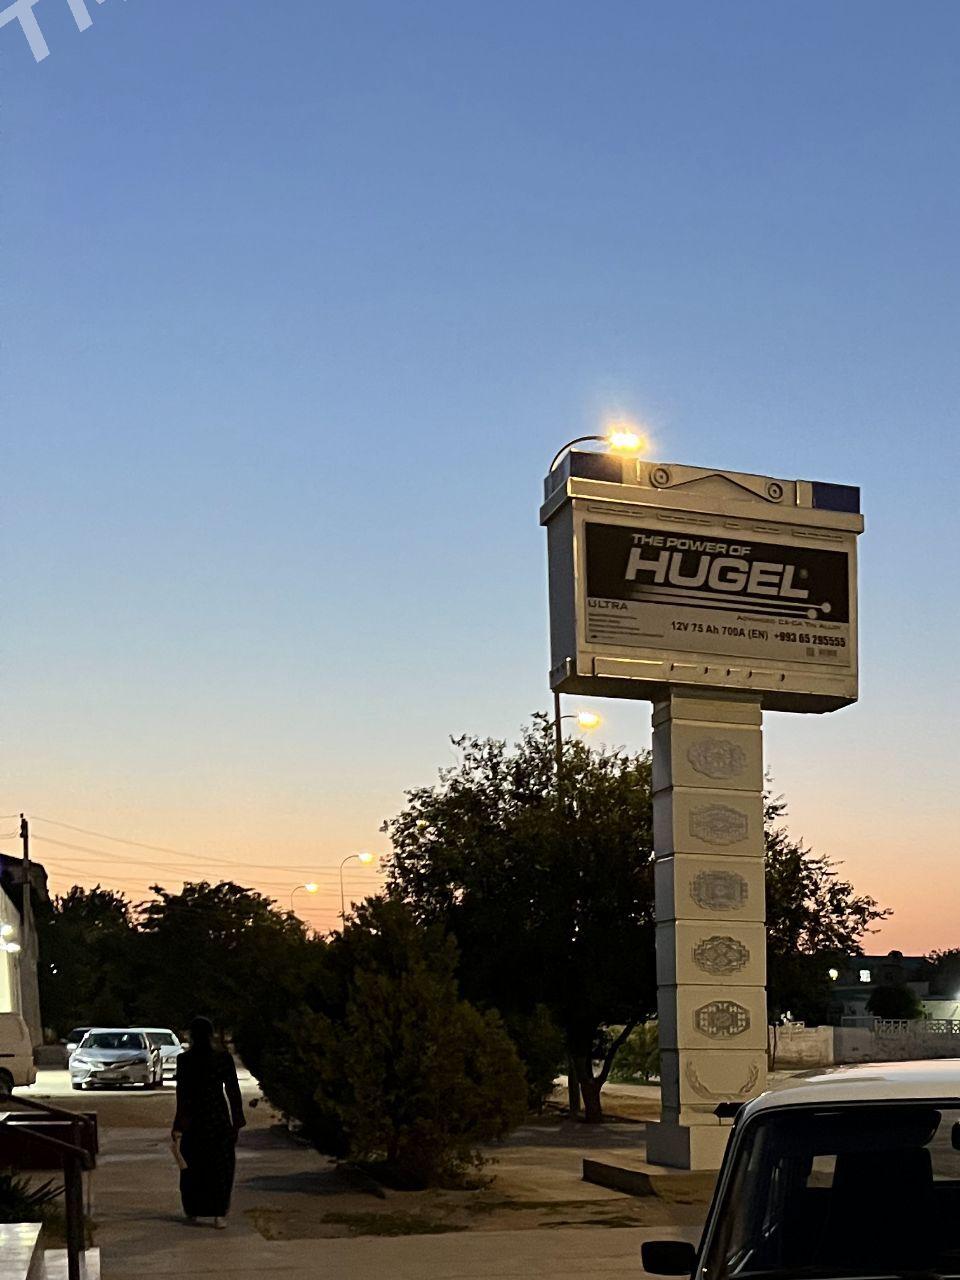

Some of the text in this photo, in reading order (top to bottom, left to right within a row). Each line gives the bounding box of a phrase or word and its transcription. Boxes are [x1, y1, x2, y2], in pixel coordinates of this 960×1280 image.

[632, 533, 752, 556] THE POWER OF
[625, 547, 809, 599] HUGEL
[588, 600, 629, 611] ULTRA
[671, 621, 690, 632] 12V
[692, 622, 704, 633] 75
[705, 624, 720, 635] Ah
[721, 626, 746, 638] 700A
[748, 629, 769, 641] (EN)
[774, 631, 797, 643] +993
